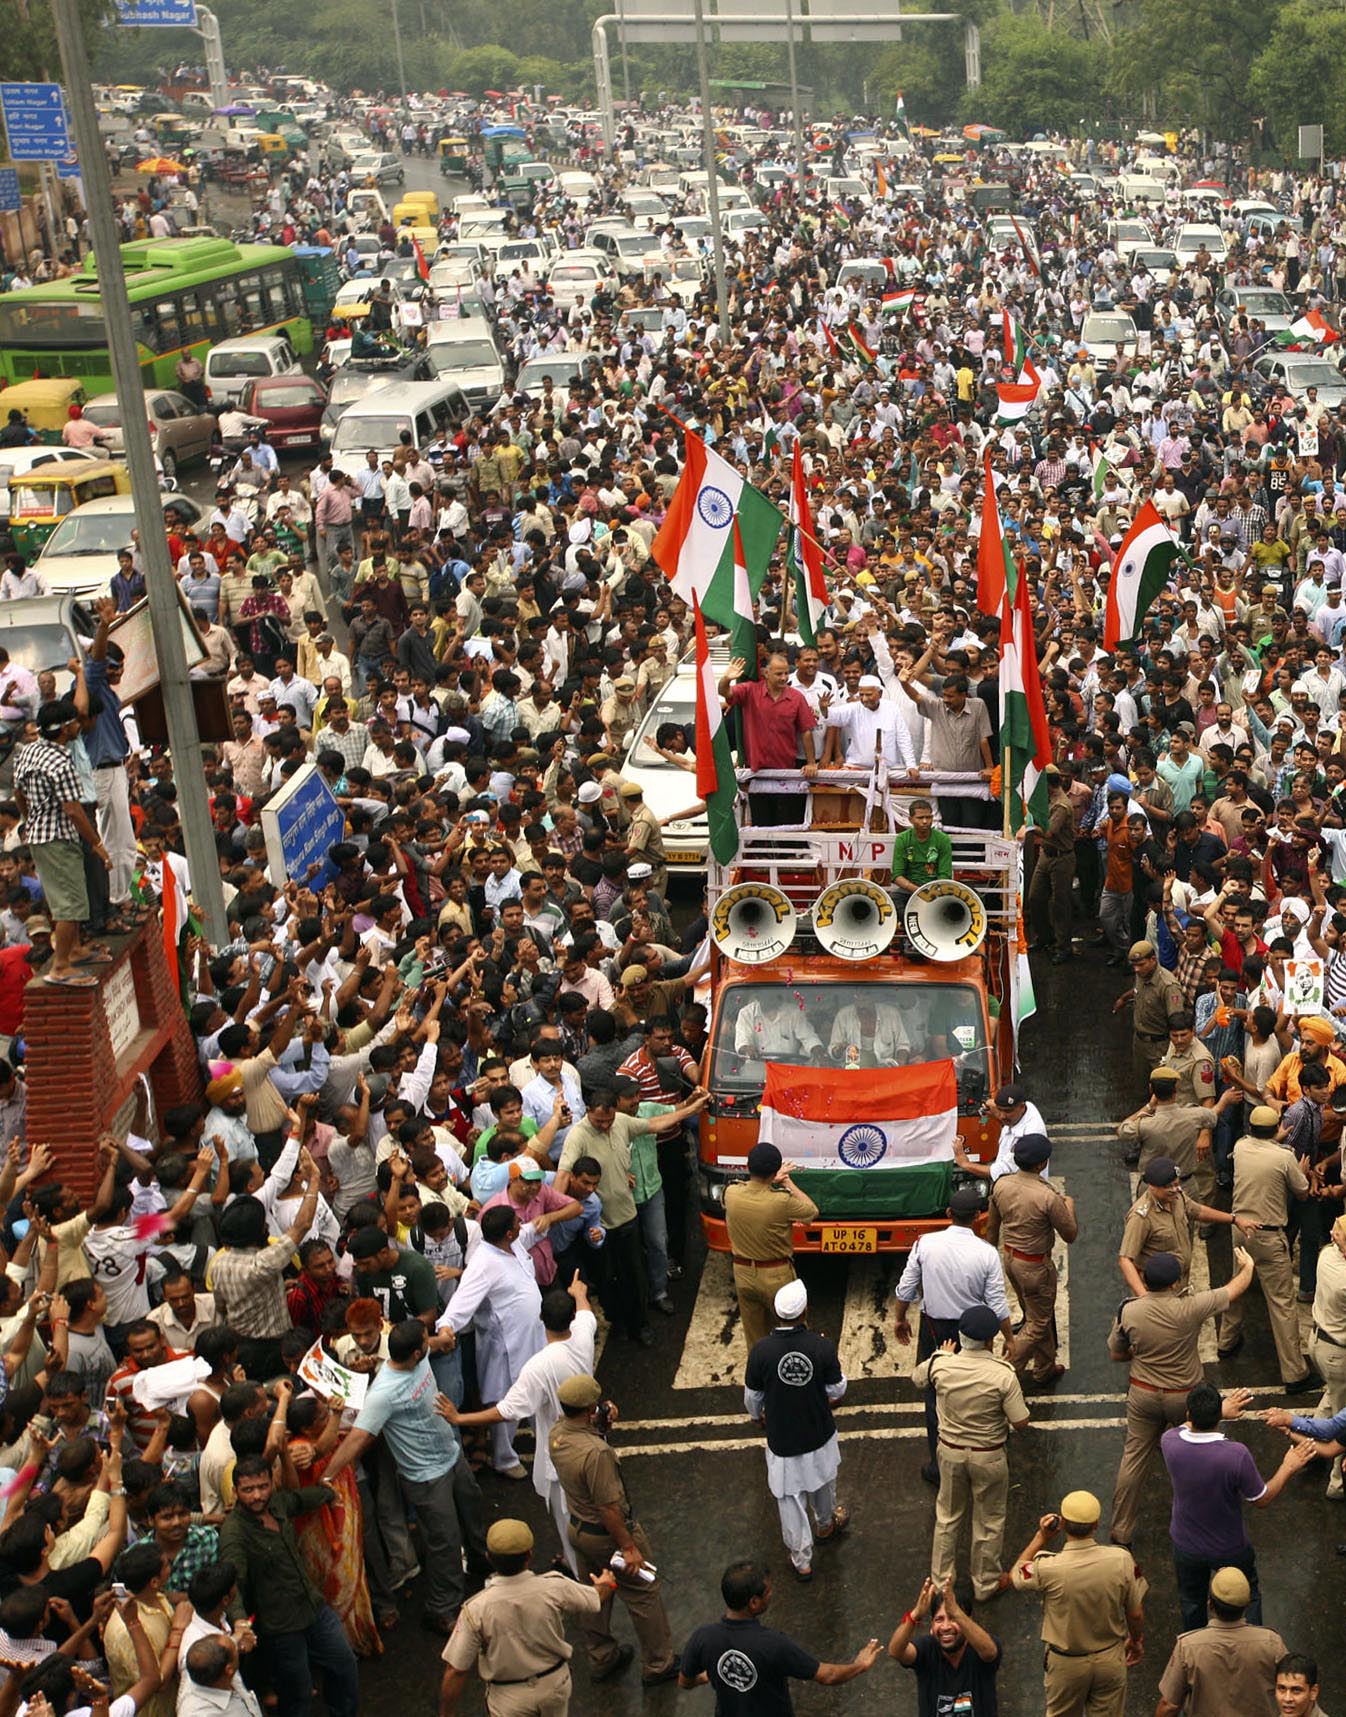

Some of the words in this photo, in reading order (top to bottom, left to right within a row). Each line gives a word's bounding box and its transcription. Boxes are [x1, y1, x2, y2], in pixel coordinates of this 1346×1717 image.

[161, 9, 190, 22] Nagar
[26, 98, 48, 107] Nagar
[24, 123, 46, 131] Nagar
[44, 148, 66, 156] Nagar
[1270, 477, 1287, 491] 85
[838, 841, 853, 861] N
[871, 842, 886, 861] P
[833, 1229, 847, 1240] UP
[852, 1229, 867, 1240] 16
